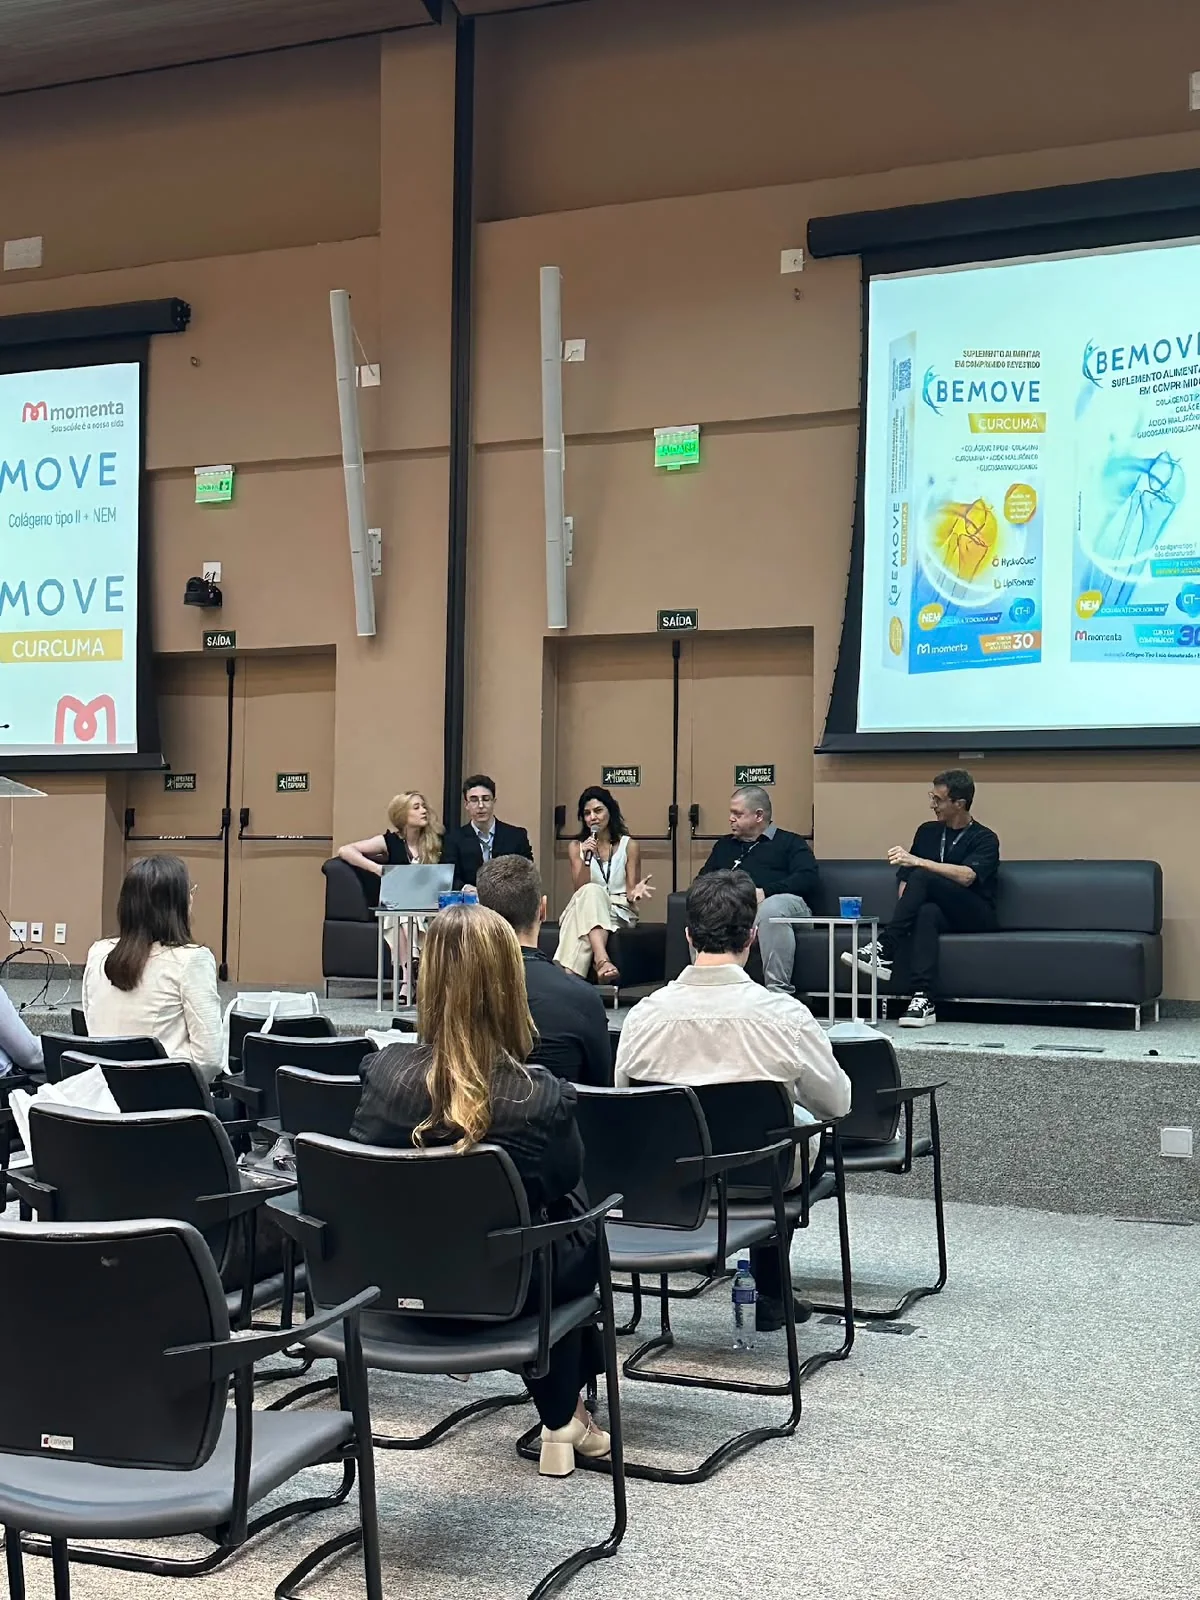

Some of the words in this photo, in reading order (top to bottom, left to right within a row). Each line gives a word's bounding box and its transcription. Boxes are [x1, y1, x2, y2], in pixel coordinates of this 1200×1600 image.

[962, 350, 1004, 358] SUPLEMENTO
[1005, 350, 1041, 358] ALIMENTAR
[1096, 331, 1200, 374] BEMOV
[966, 360, 1006, 369] COMPRIMIDO
[1006, 360, 1041, 369] REVESTIDO
[1111, 371, 1162, 388] SUPLEMENTO
[936, 379, 1041, 402] BEMOVE
[1139, 385, 1151, 395] EM
[50, 401, 124, 421] momenta
[978, 417, 1039, 430] CURCUMA
[9, 511, 53, 529] Colágeno
[55, 510, 73, 528] tipo
[93, 506, 117, 523] NEM
[890, 502, 900, 594] BEMOVE
[1080, 599, 1100, 612] NEM
[662, 613, 693, 627] SAÍDA
[921, 612, 941, 624] NEM
[206, 634, 231, 646] SAÍDA
[1012, 633, 1034, 650] 30
[1088, 633, 1122, 642] momenta
[12, 637, 105, 658] CURCUMA
[931, 643, 968, 654] momenta
